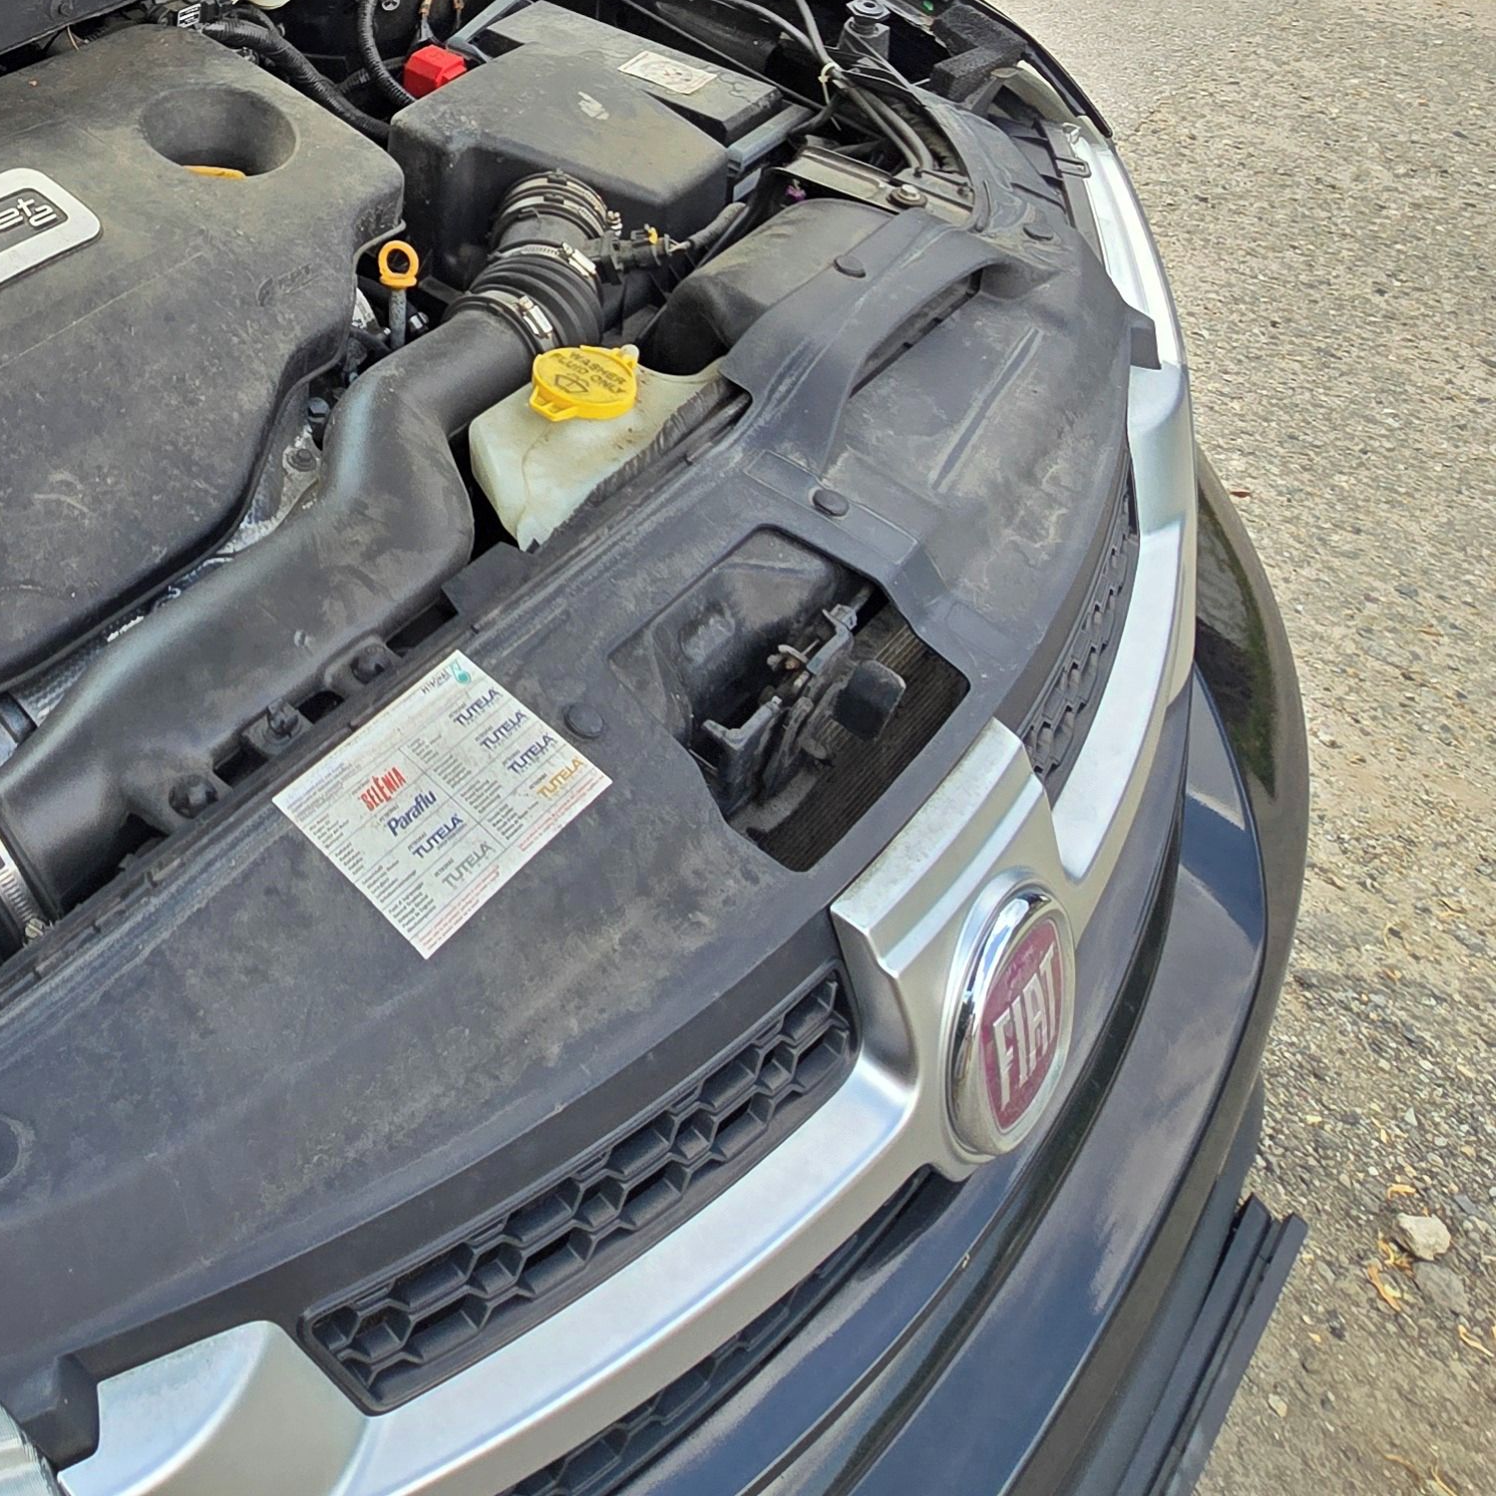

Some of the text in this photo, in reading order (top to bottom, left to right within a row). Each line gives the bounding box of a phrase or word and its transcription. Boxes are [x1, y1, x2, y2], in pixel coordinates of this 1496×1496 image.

[549, 352, 627, 394] FLUID ONLY
[569, 351, 627, 385] WASHER
[453, 686, 502, 728] TUTELA
[480, 709, 527, 752] TUTELA
[507, 732, 557, 776] TUTELA
[536, 756, 584, 799] TUTELA
[386, 789, 437, 837] Paraflu
[412, 813, 465, 860] TUTELA
[442, 840, 494, 889] TUTELA
[992, 940, 1055, 1112] FIAT
